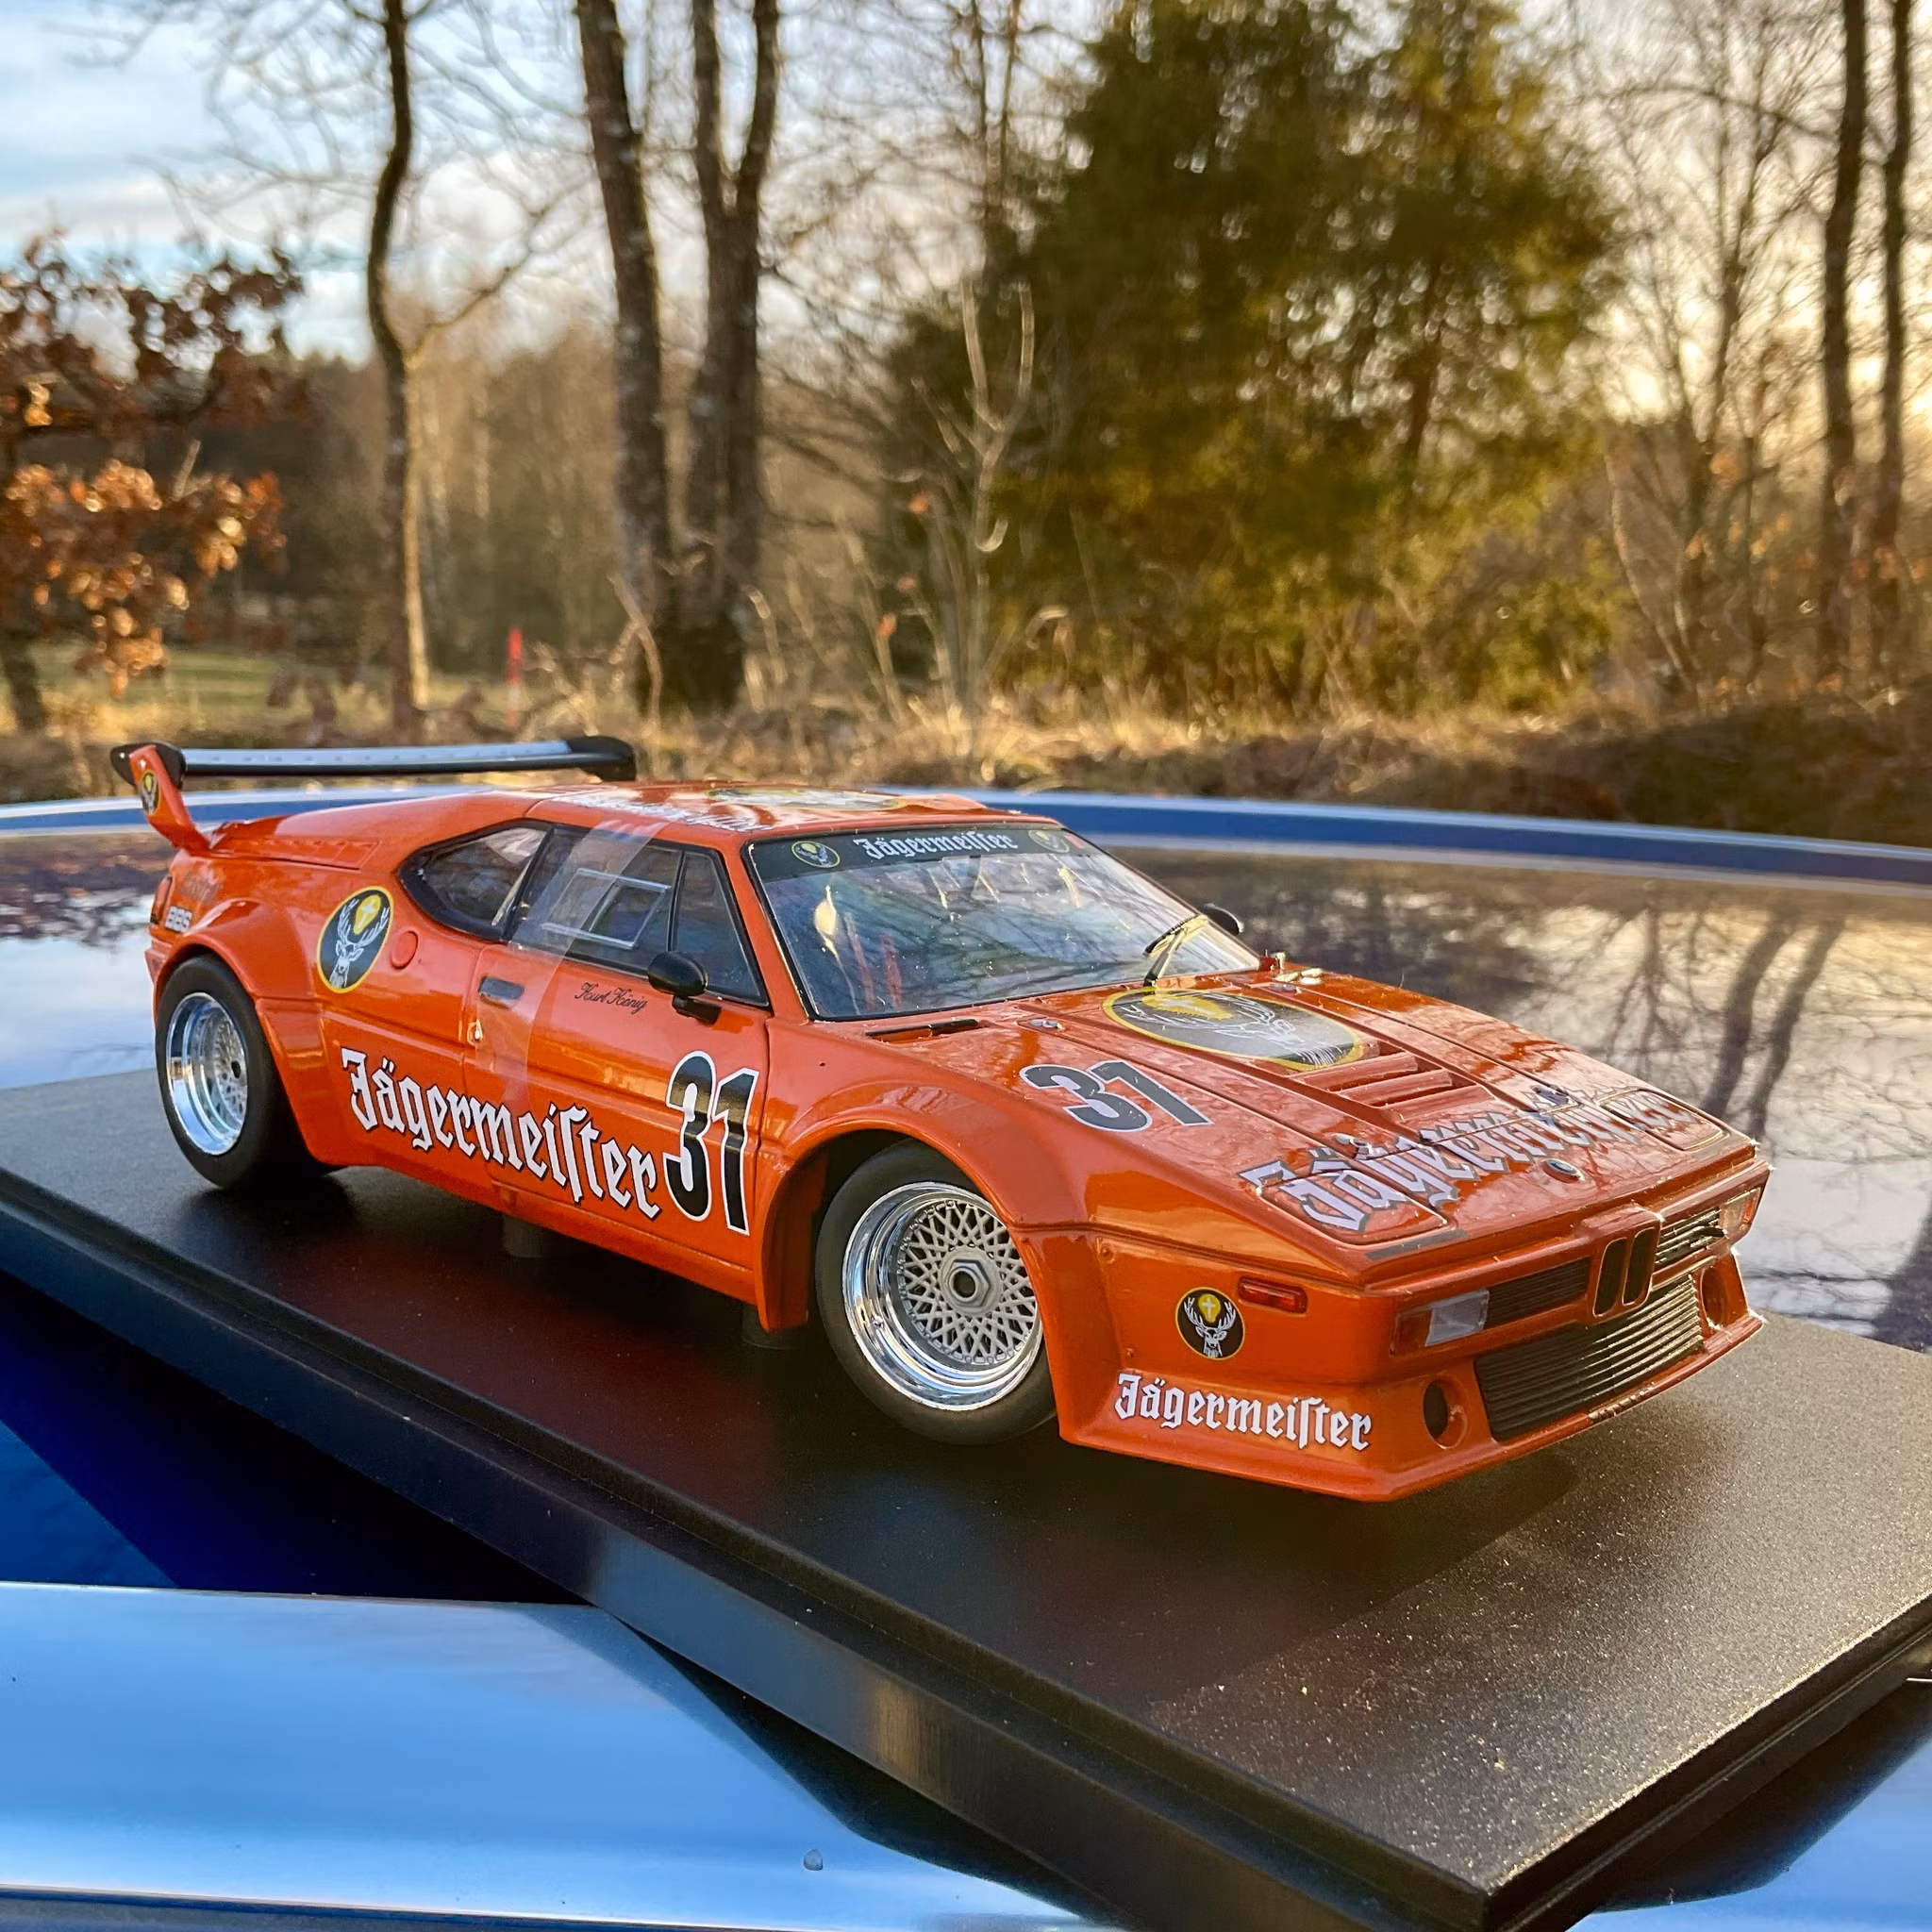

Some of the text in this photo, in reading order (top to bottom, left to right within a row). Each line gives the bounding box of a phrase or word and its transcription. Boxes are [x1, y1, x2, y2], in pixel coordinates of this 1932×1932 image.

[853, 831, 1018, 860] Jägermeister
[165, 906, 192, 933] BBS
[1019, 1059, 1214, 1132] 31
[341, 1046, 661, 1221] Jägermeister
[662, 1051, 759, 1236] 31
[1114, 1373, 1372, 1451] Jägermeister
